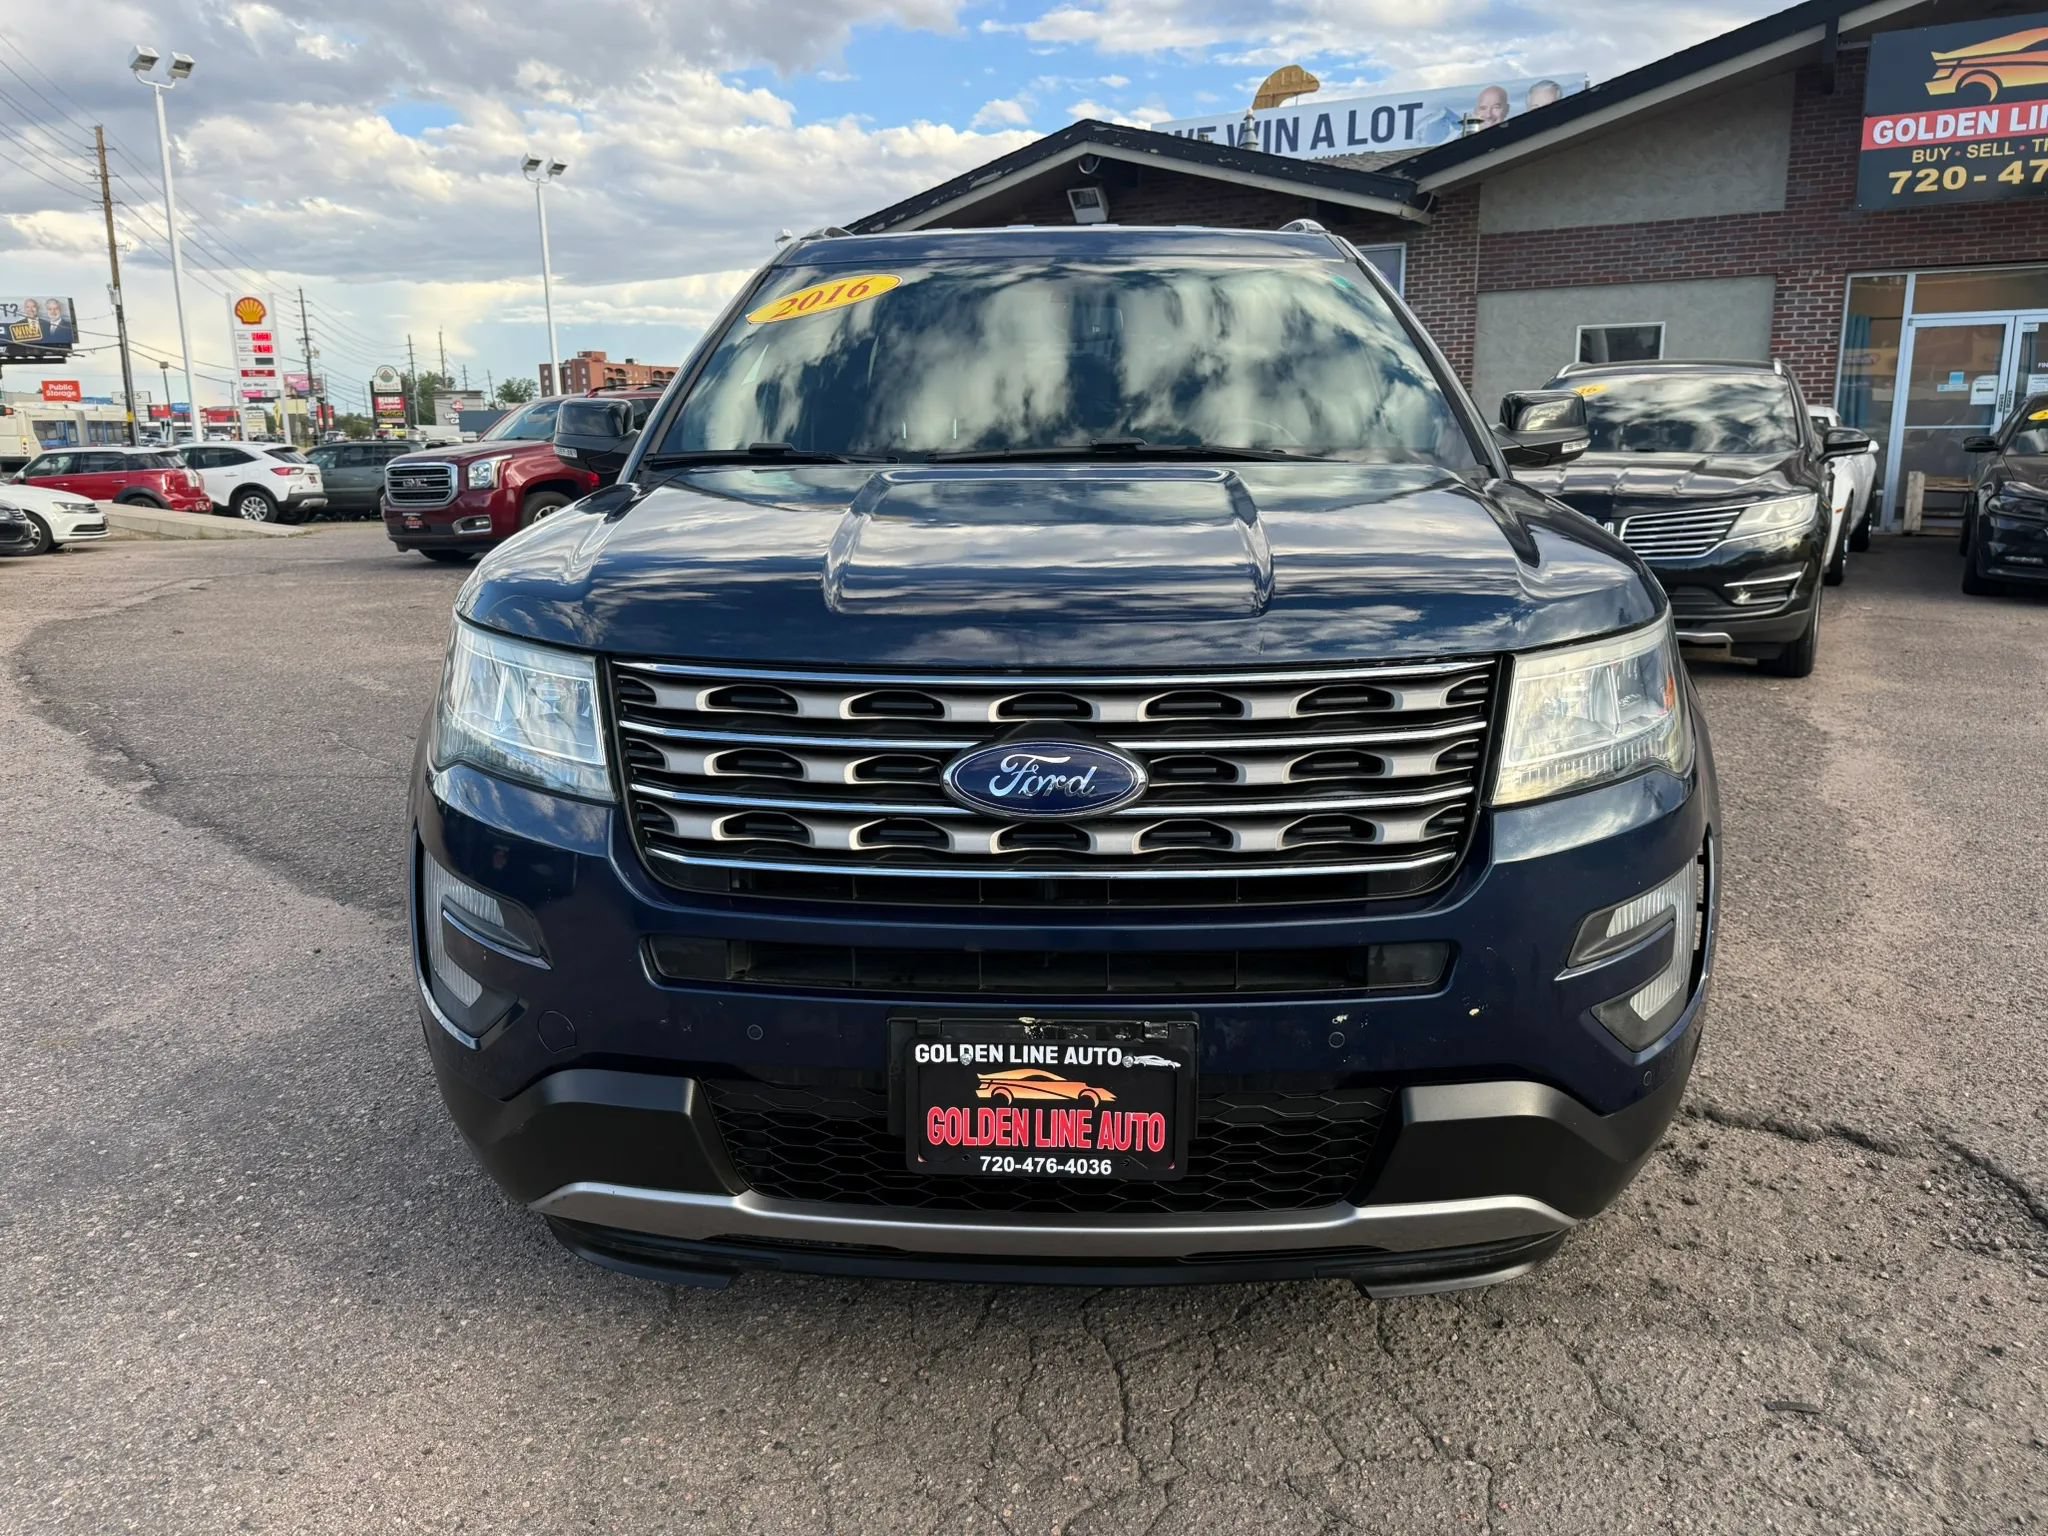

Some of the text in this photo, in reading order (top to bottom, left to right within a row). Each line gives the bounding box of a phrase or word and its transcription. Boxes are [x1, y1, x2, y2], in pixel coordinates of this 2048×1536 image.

[1310, 113, 1335, 150] A
[1347, 102, 1423, 146] LOT
[1873, 109, 1999, 144] GOLDEN
[1912, 146, 1952, 163] BUY
[1966, 141, 2015, 158] SELL
[770, 277, 875, 319] 2016
[46, 390, 77, 398] Storage
[48, 383, 73, 391] Public
[402, 478, 428, 488] GMC
[989, 753, 1096, 797] Ford
[915, 1043, 1122, 1067] GOLDEN LINE AUTO
[927, 1106, 1166, 1153] GOLDEN LINE AUTO
[980, 1155, 1112, 1175] 720-476-4036
